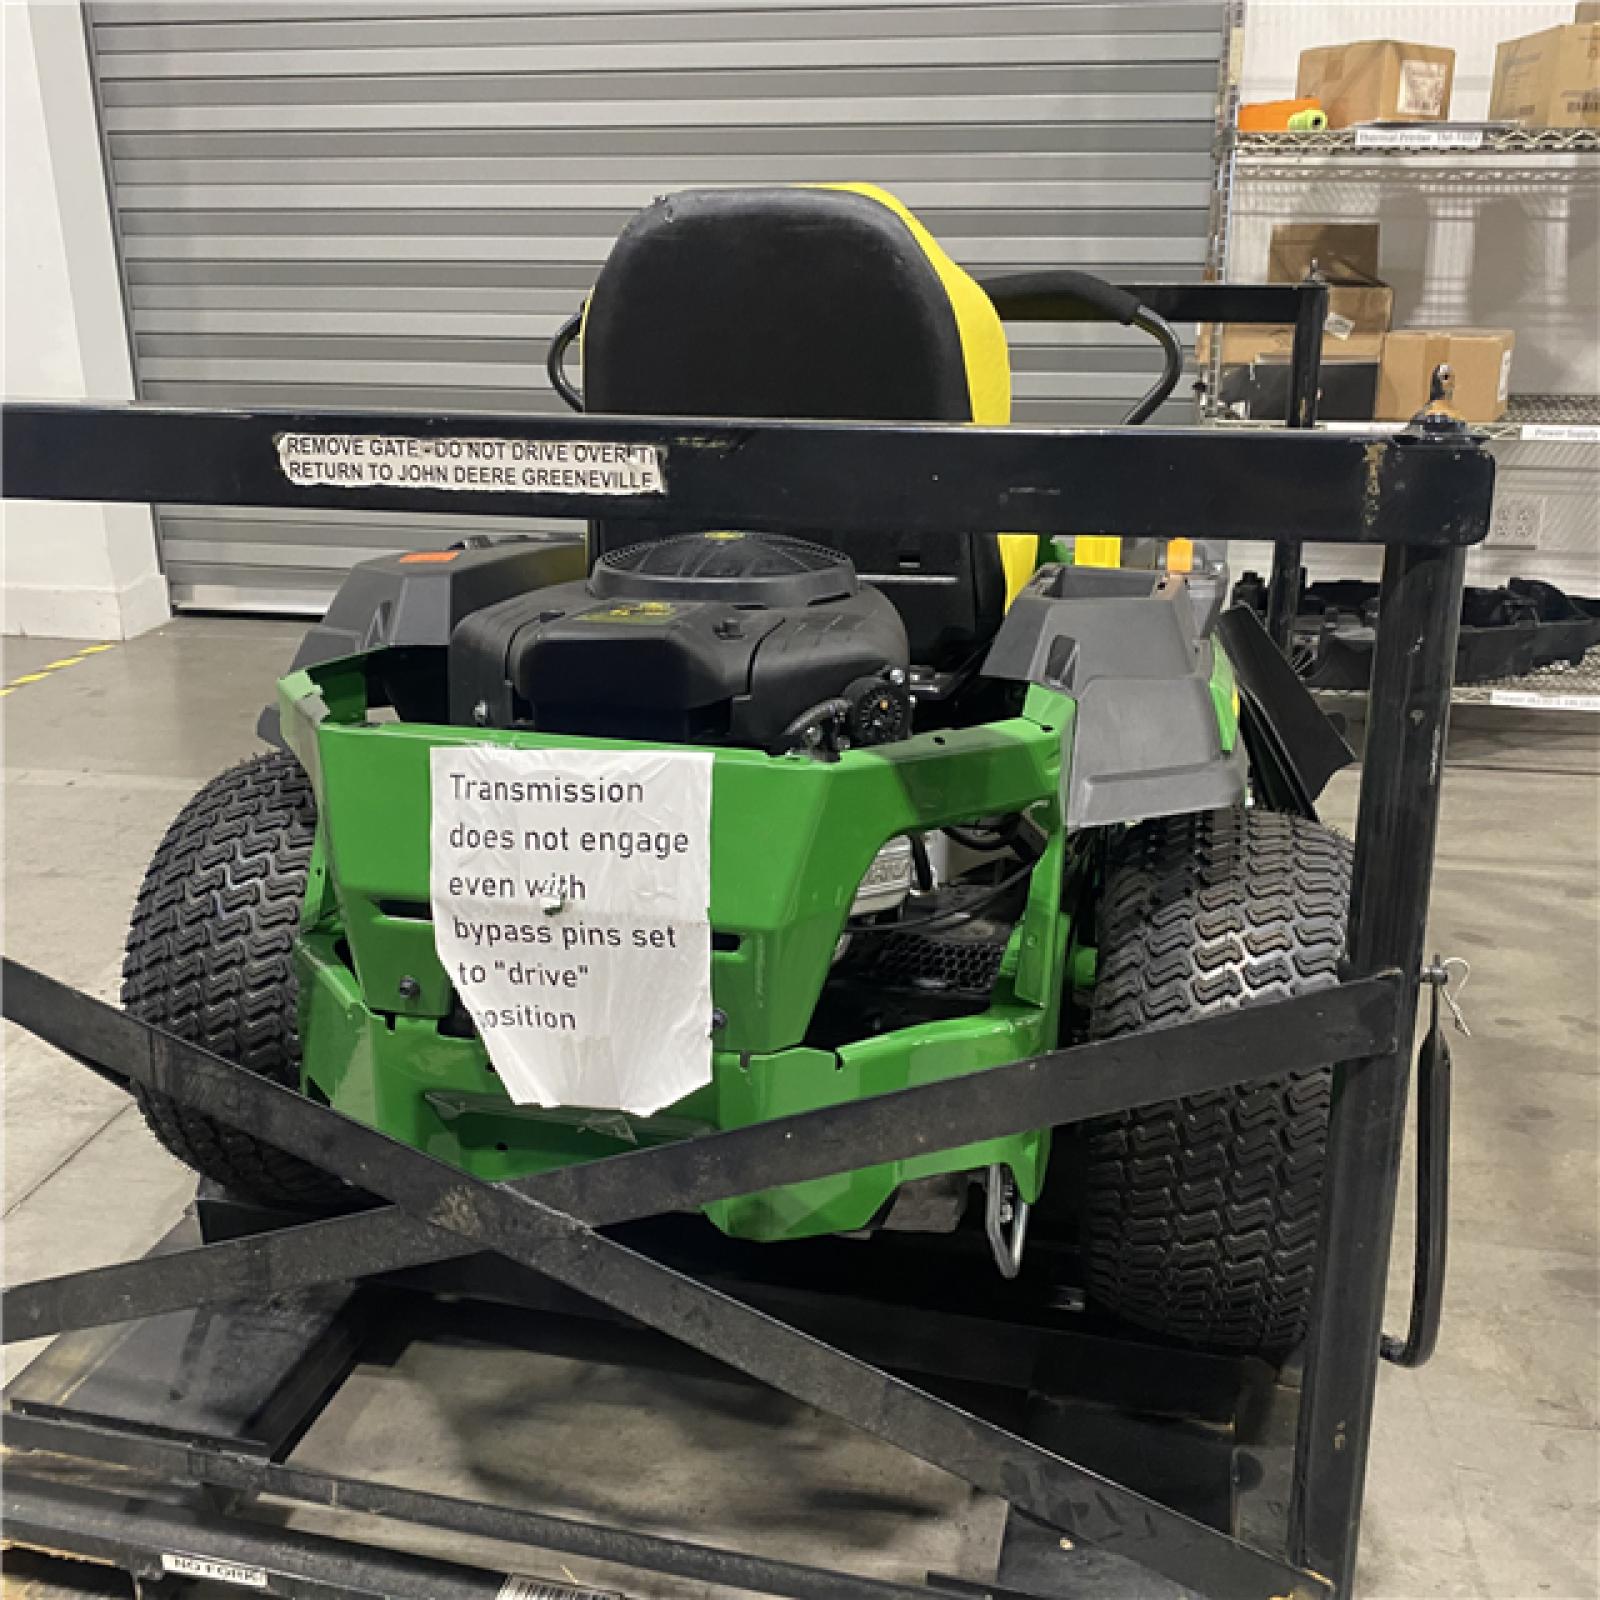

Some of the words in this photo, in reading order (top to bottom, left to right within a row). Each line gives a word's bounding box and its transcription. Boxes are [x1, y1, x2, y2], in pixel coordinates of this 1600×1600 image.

[286, 437, 363, 456] REMOVE
[369, 438, 419, 458] GATE
[435, 442, 462, 459] DO
[466, 442, 506, 461] NOT
[511, 442, 568, 463] DRIVE
[574, 444, 626, 463] OVER
[289, 461, 363, 481] RETURN
[368, 462, 393, 481] TO
[397, 464, 449, 484] JOHN
[454, 466, 516, 486] DEERE
[522, 469, 653, 489] GREENEVILLE
[449, 773, 644, 804] Transmission
[449, 821, 516, 850] does
[524, 826, 569, 852] not
[580, 831, 690, 859] engage
[449, 875, 516, 898] even
[524, 872, 587, 900] with
[454, 915, 552, 947] bypass
[562, 920, 622, 950] pins
[632, 925, 677, 949] set
[458, 961, 487, 986] to
[494, 959, 589, 989] "drive"
